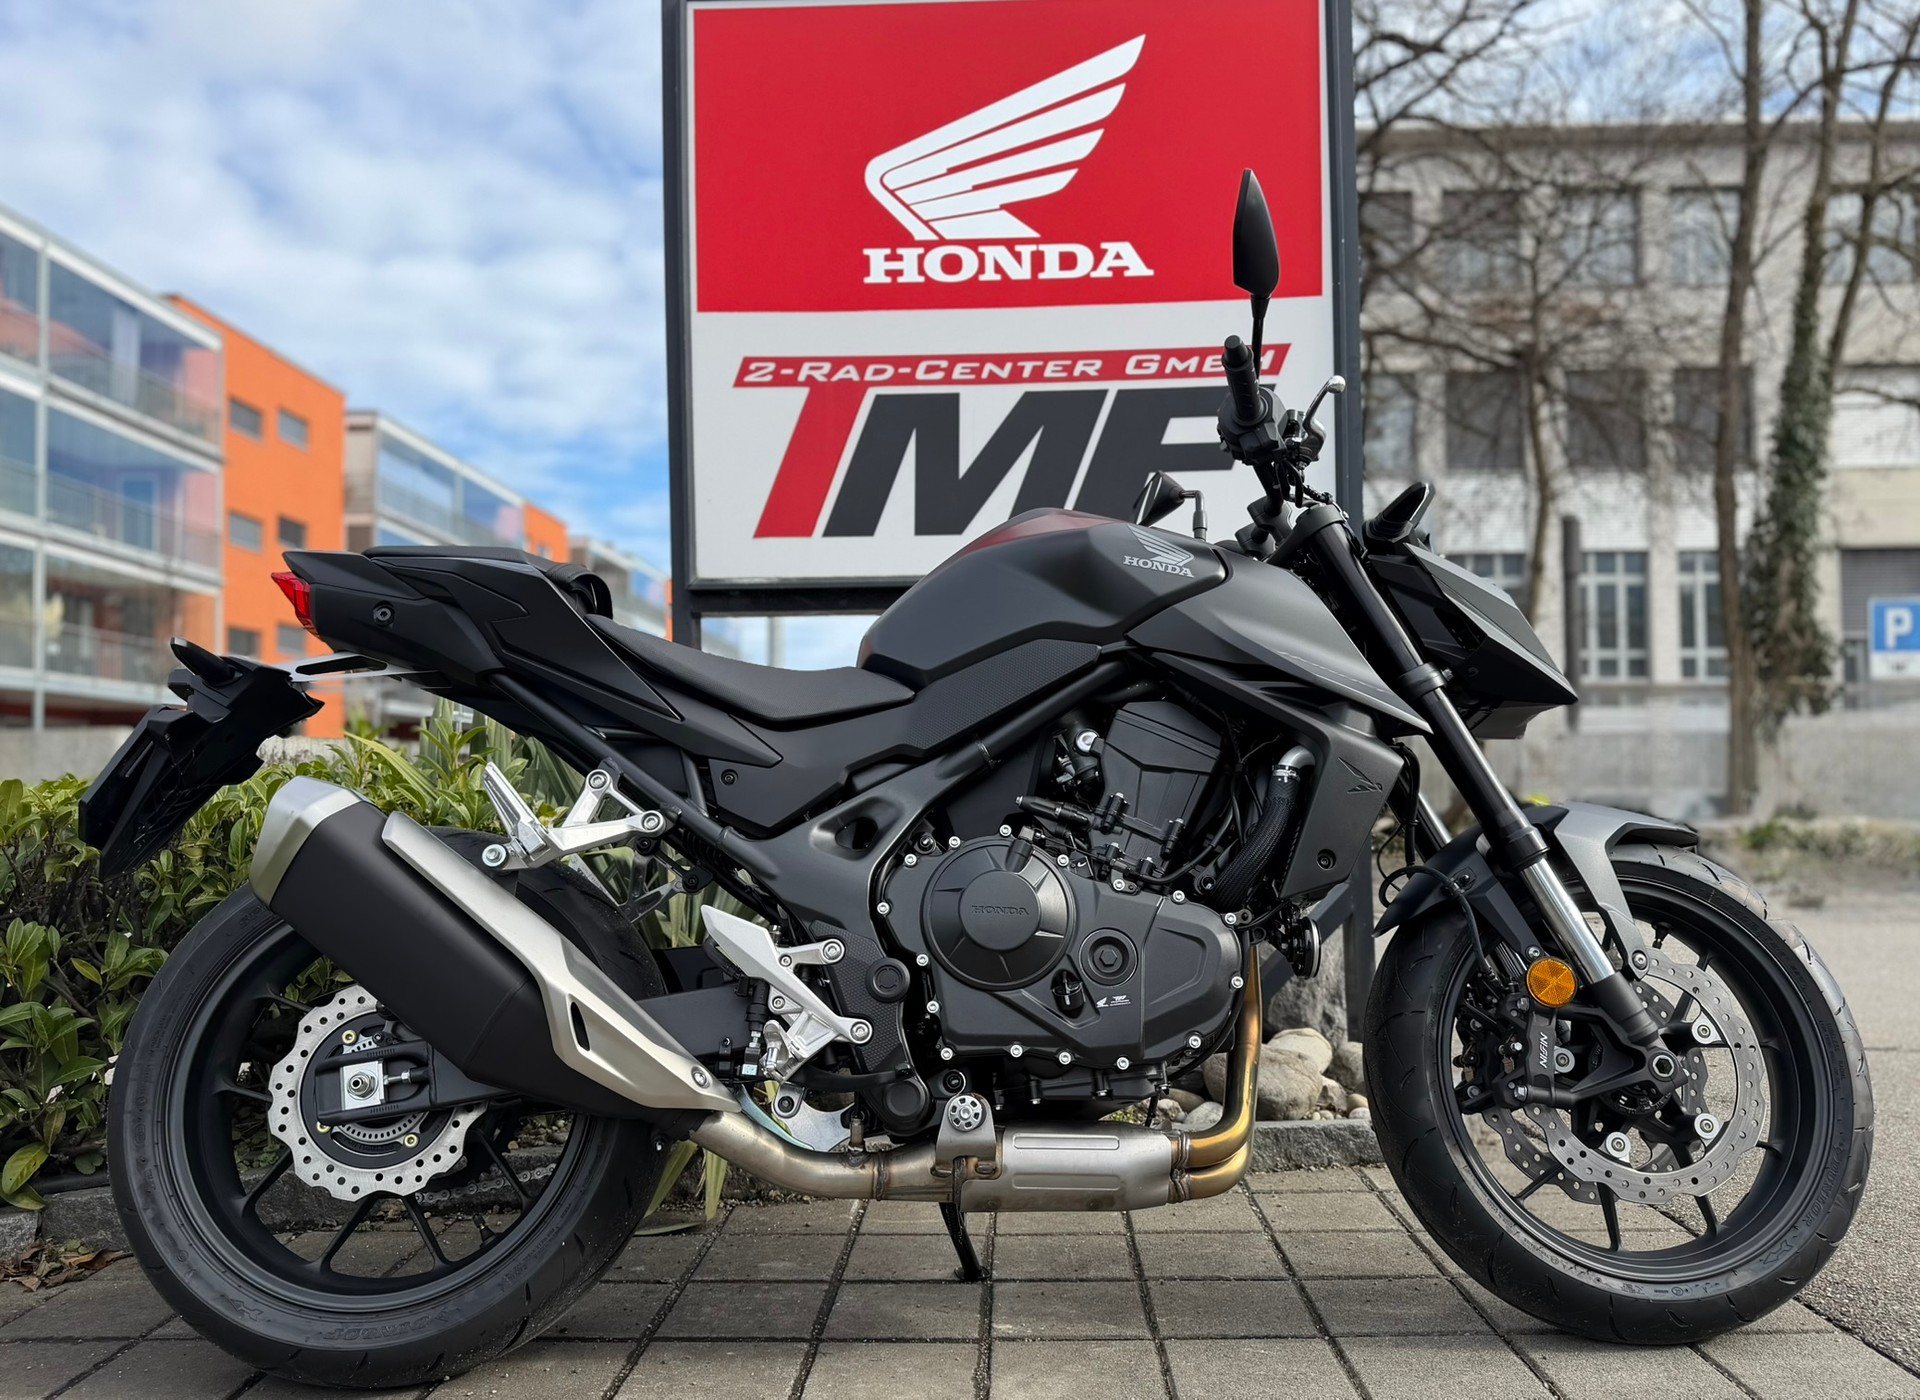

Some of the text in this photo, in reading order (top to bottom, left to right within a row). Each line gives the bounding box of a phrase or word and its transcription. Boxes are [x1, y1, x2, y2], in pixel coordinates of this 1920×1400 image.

[863, 241, 1154, 284] HONDA
[752, 384, 1277, 538] TMF
[1122, 555, 1195, 578] HONDA
[1885, 607, 1914, 650] P
[971, 905, 1030, 916] HONDA
